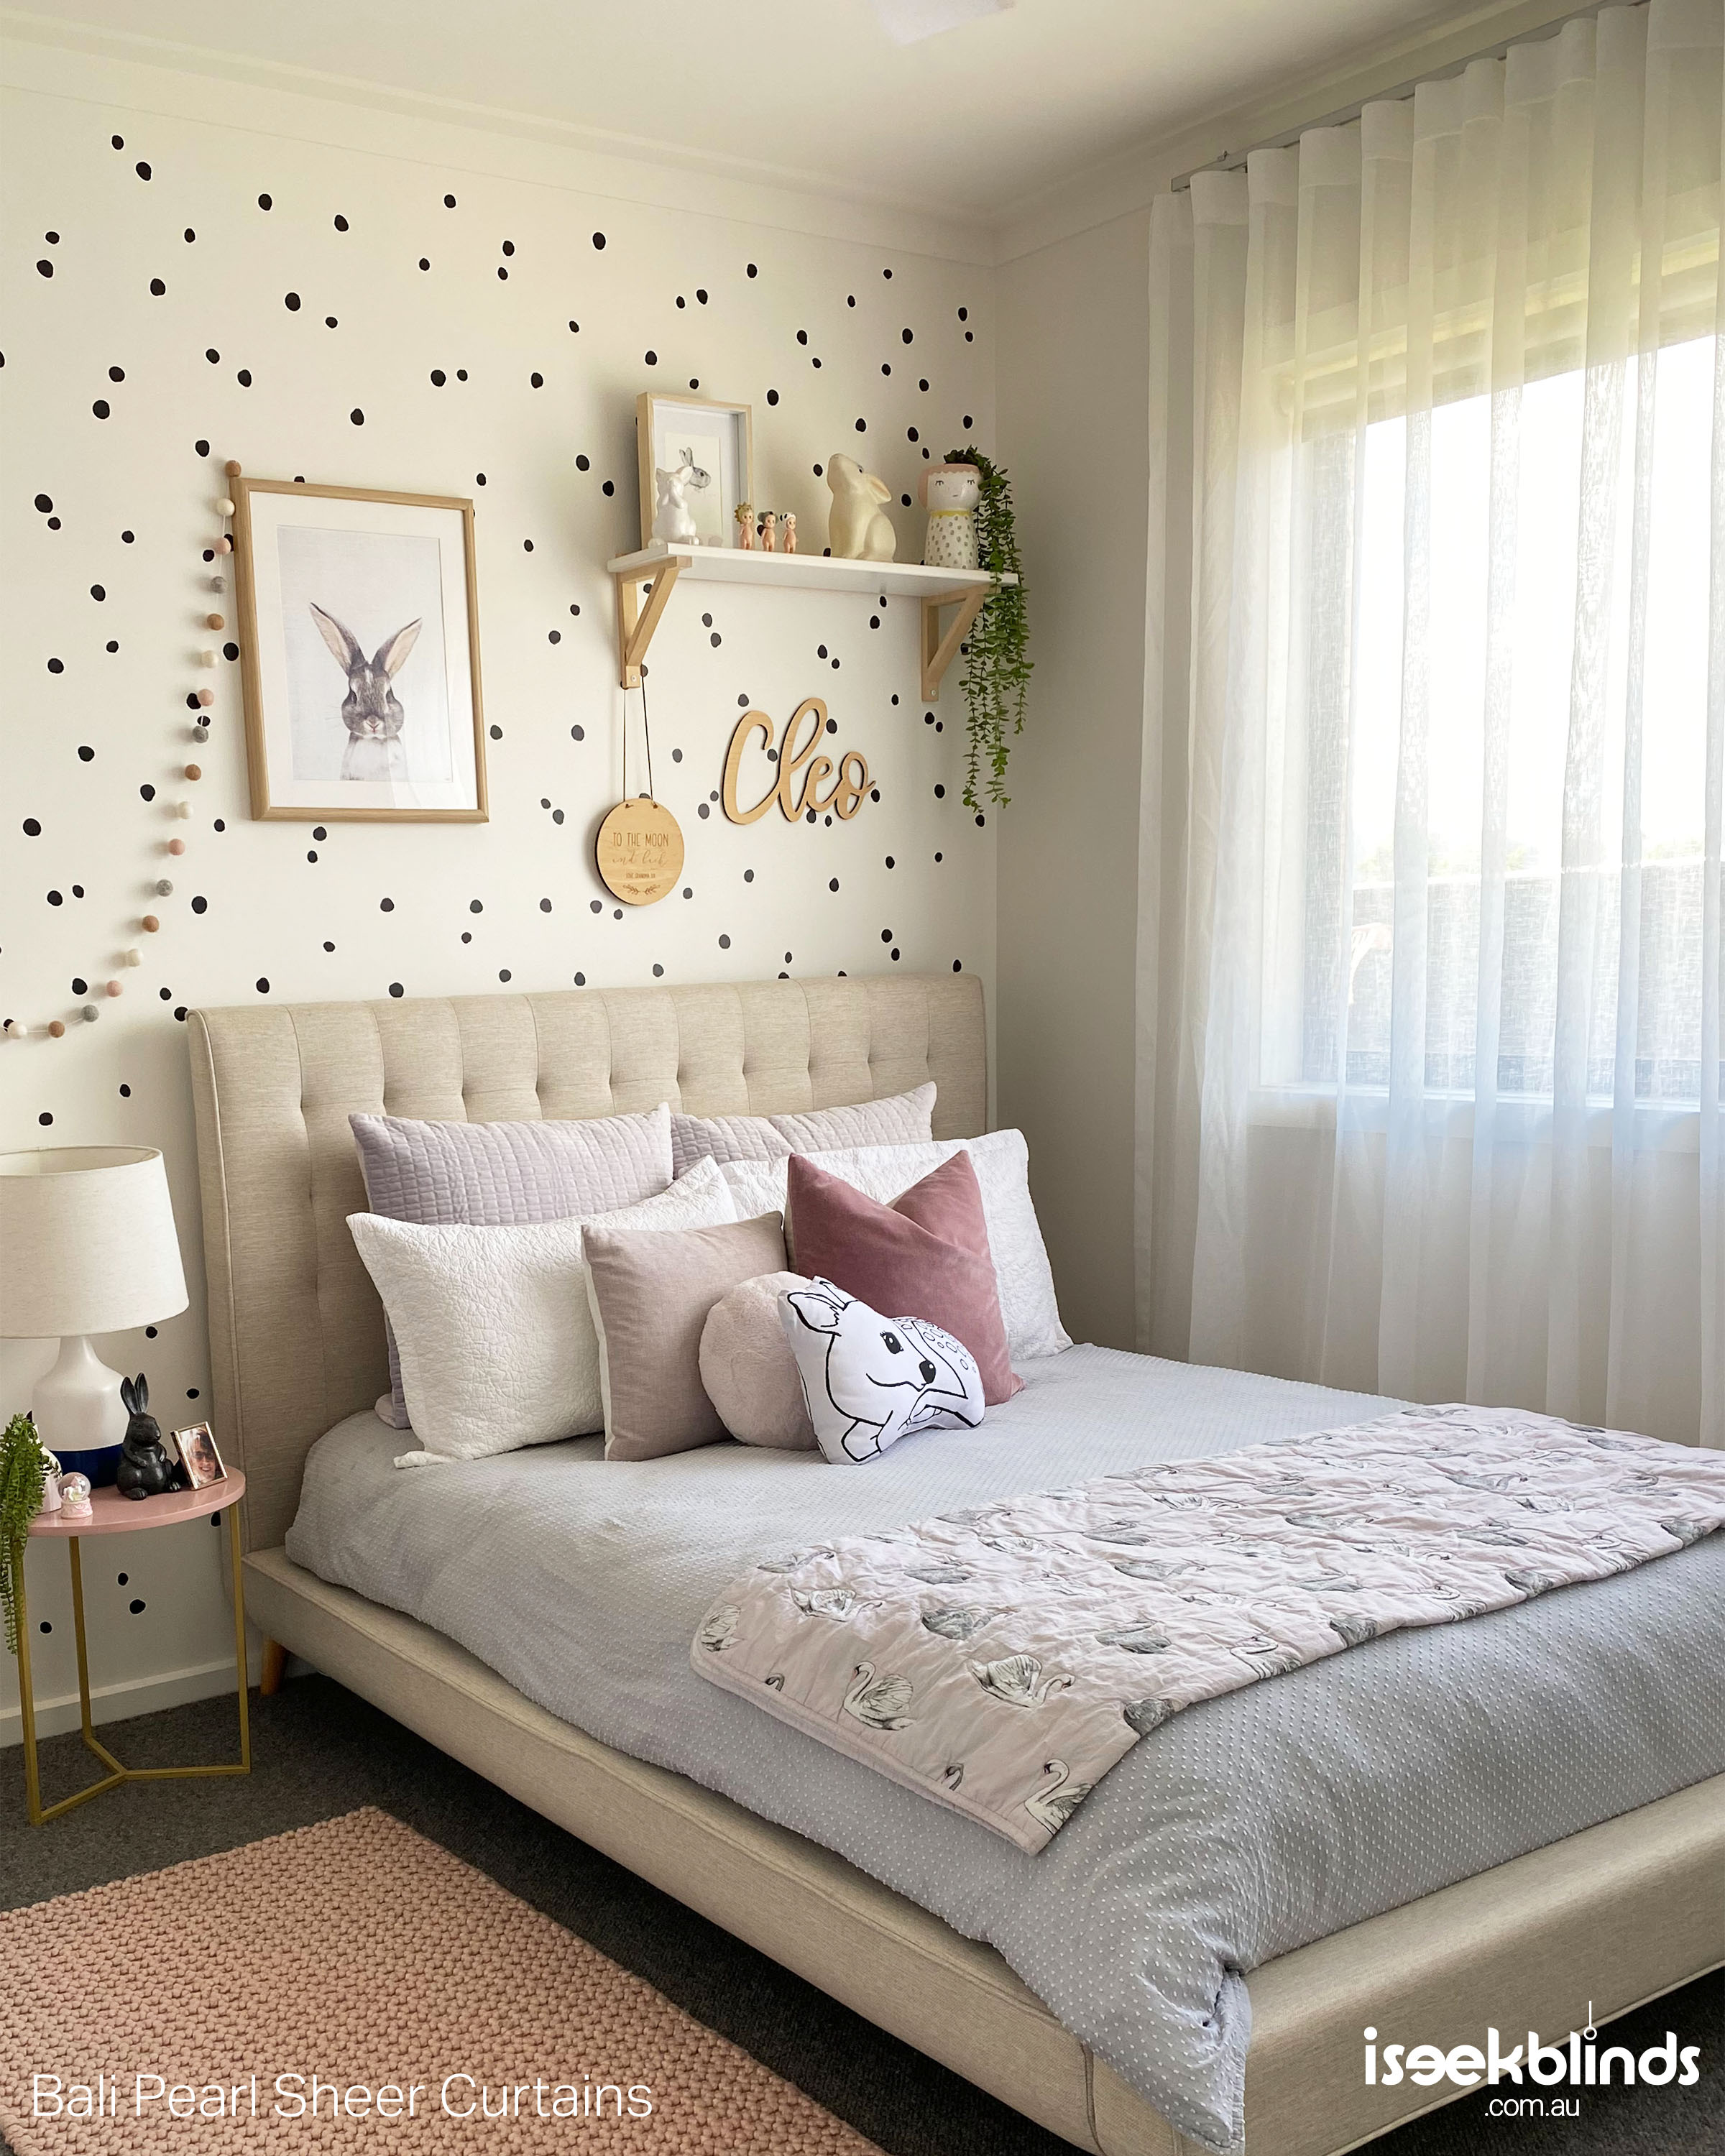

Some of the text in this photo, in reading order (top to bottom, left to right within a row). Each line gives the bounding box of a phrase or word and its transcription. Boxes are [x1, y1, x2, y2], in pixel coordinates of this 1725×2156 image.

[722, 697, 876, 824] Cleo
[613, 832, 668, 847] TO THE MOON
